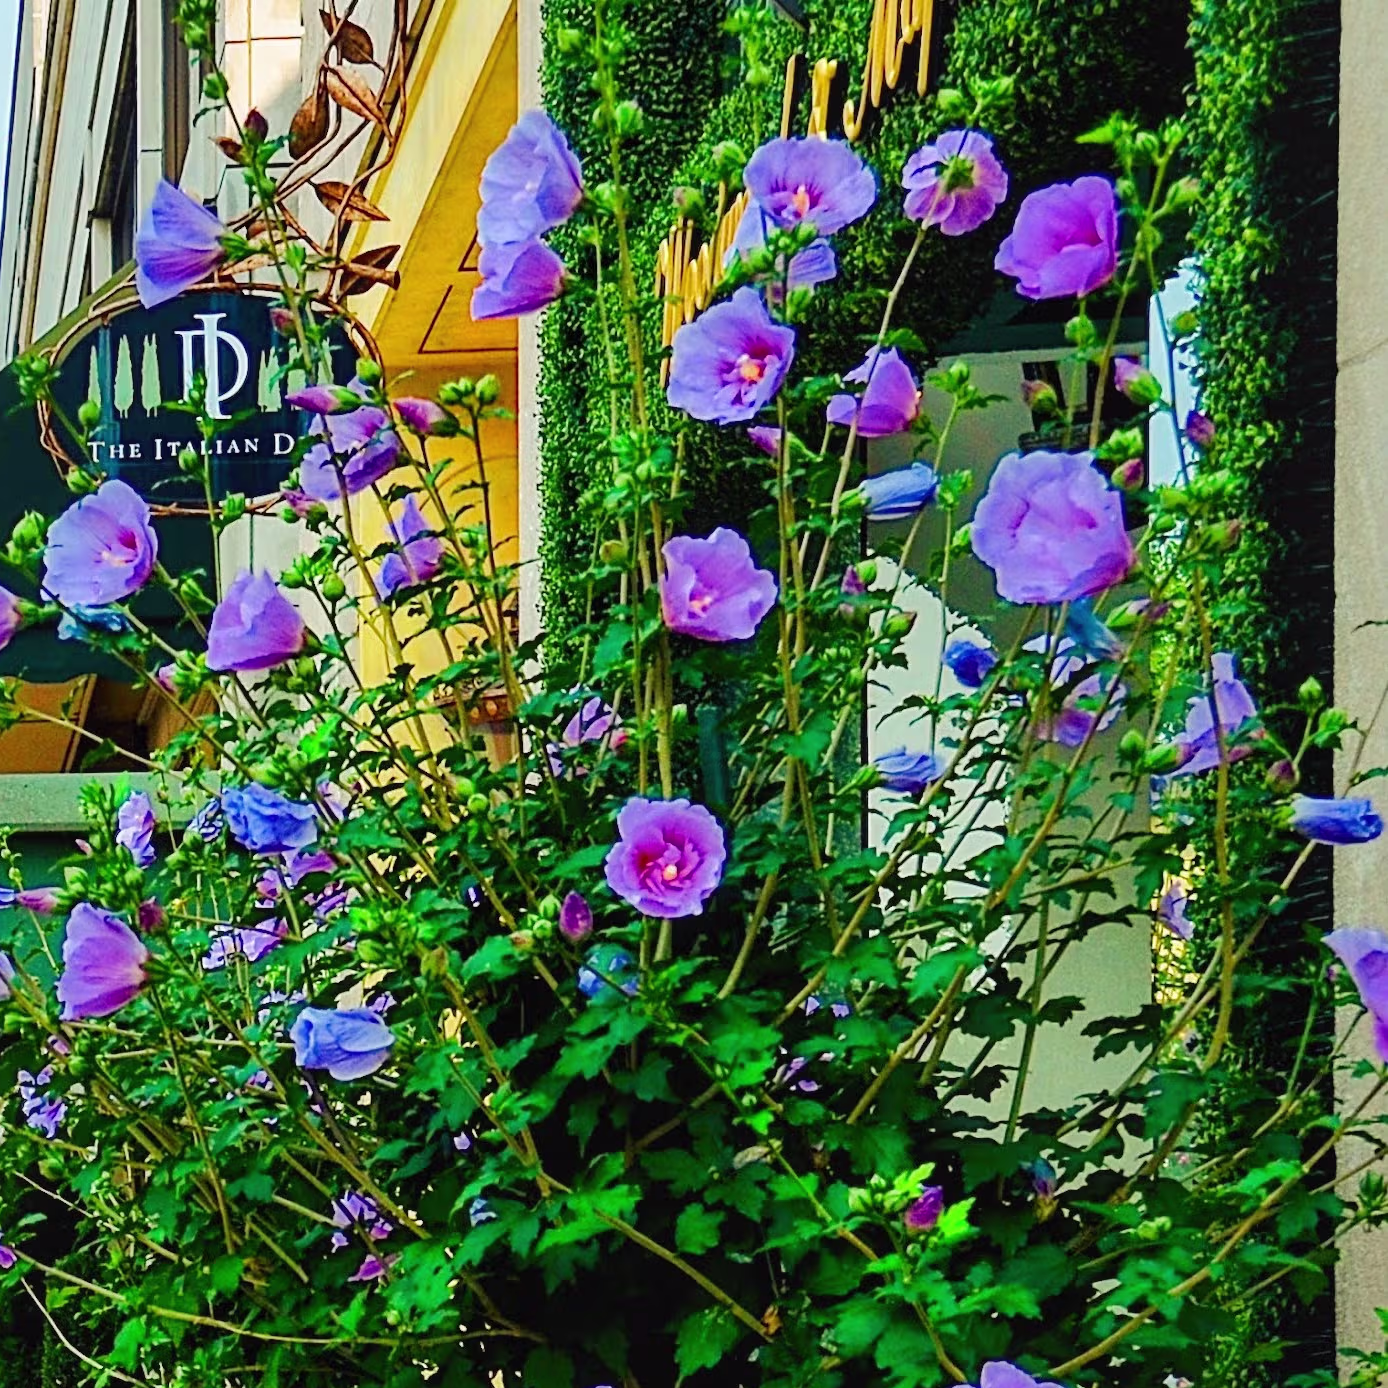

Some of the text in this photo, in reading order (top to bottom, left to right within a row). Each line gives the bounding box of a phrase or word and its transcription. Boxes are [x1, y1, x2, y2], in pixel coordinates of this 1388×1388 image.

[86, 433, 296, 463] THE ITALIAN D
